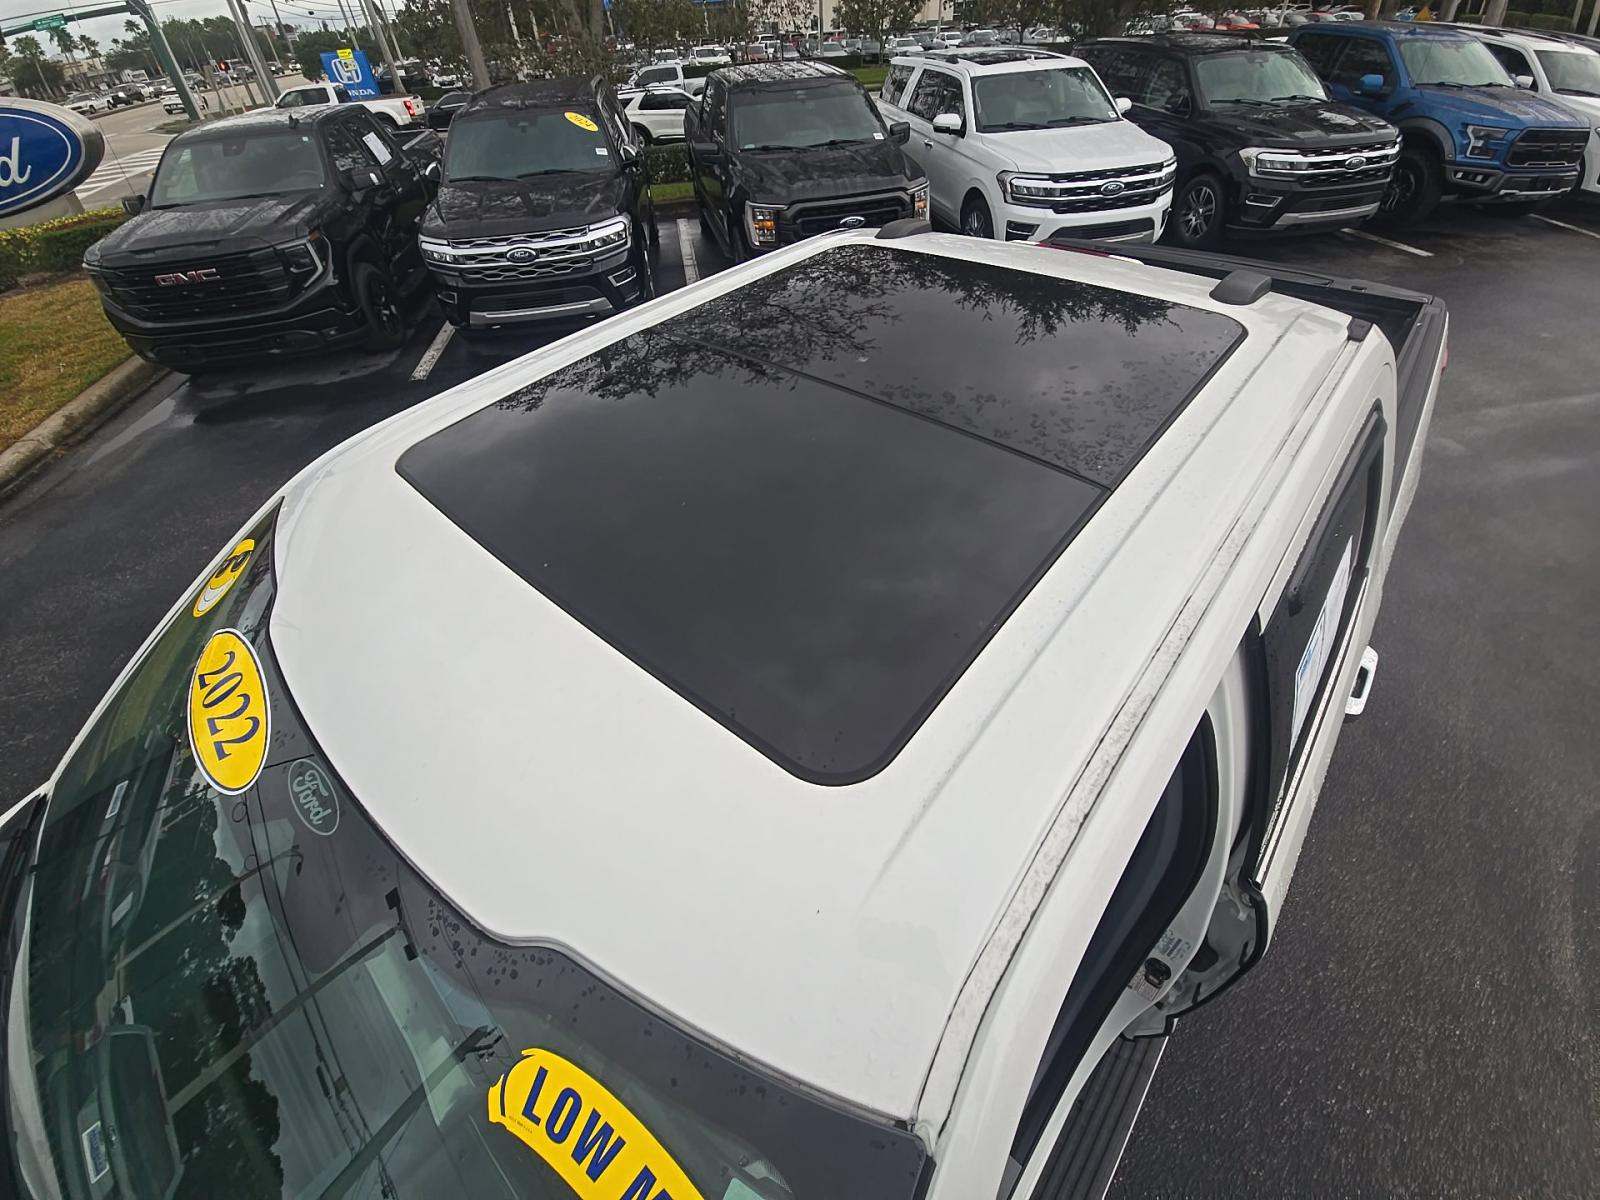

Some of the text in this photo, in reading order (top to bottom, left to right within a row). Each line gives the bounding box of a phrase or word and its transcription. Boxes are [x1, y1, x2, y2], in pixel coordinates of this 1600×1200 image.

[347, 88, 376, 97] NDA
[153, 267, 221, 286] GMC
[198, 651, 260, 761] 2022
[293, 769, 332, 825] Ford
[521, 1065, 627, 1184] LOW
